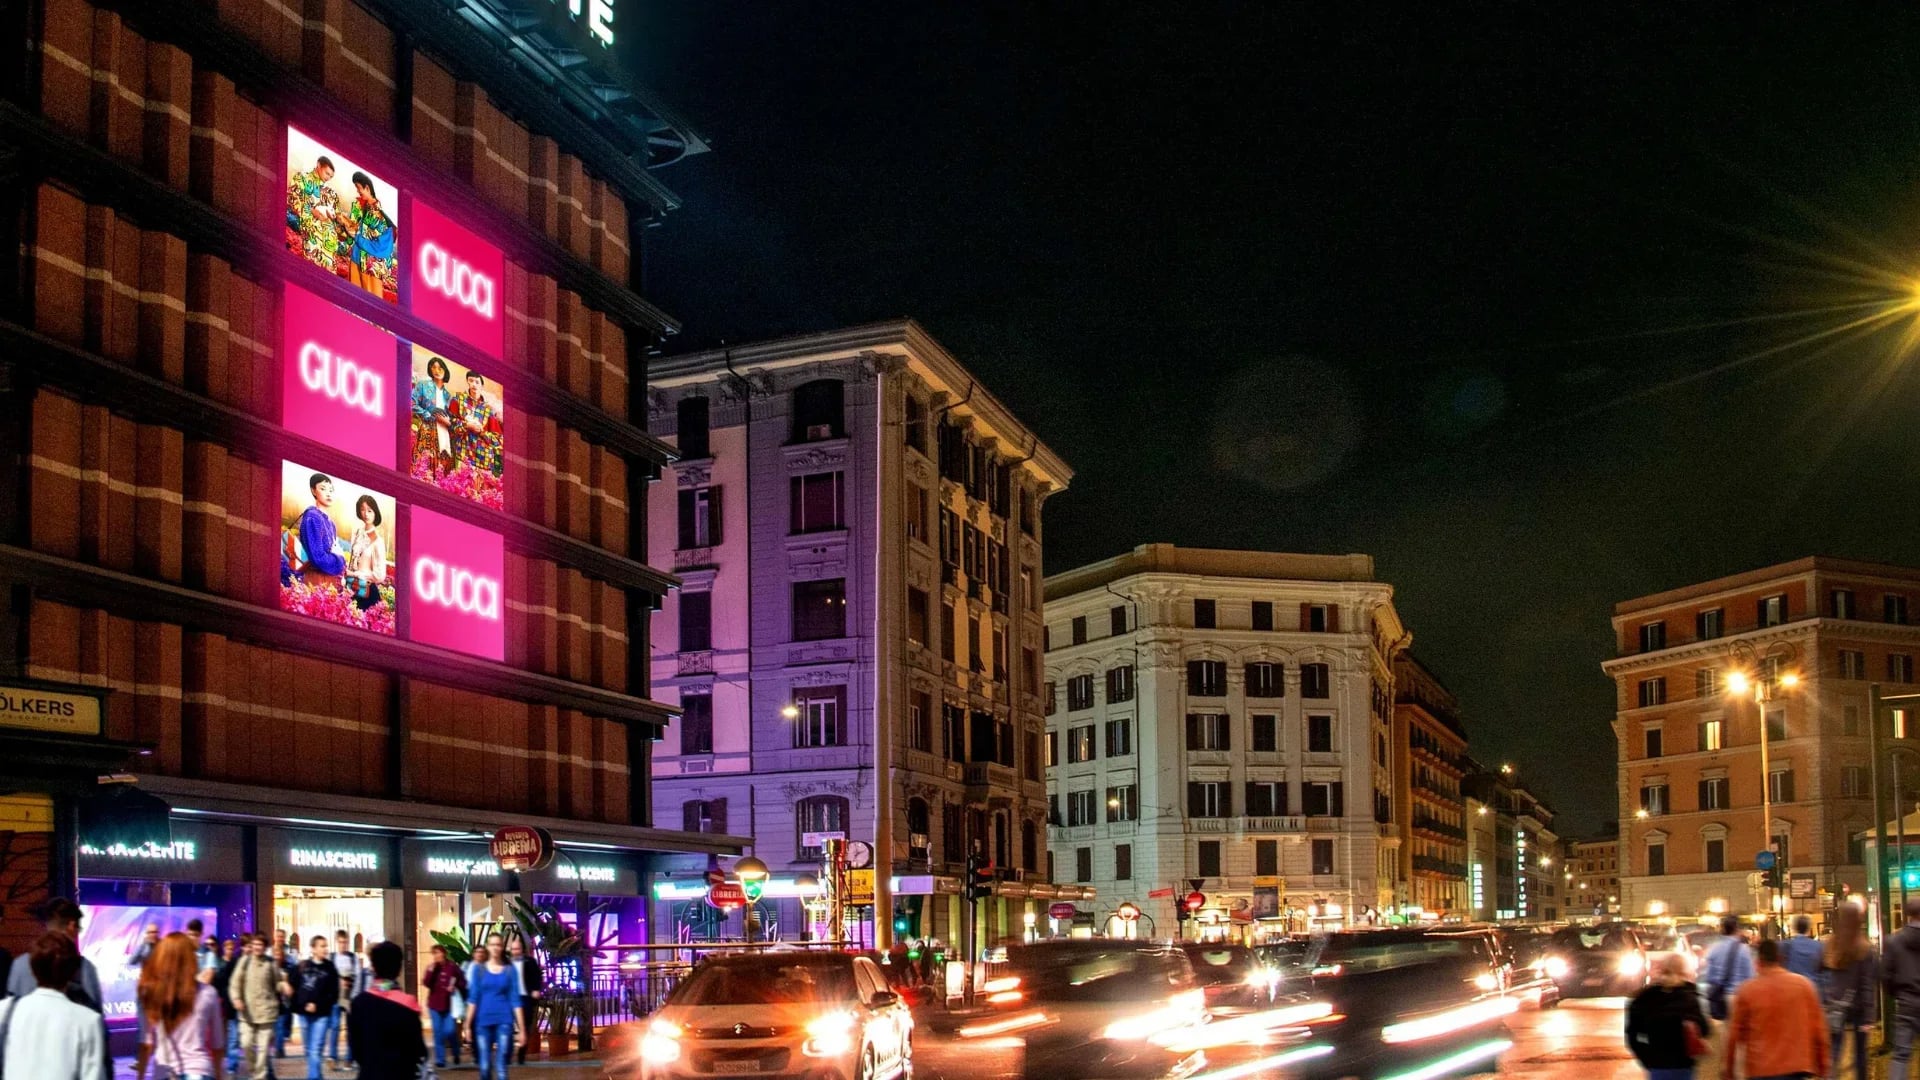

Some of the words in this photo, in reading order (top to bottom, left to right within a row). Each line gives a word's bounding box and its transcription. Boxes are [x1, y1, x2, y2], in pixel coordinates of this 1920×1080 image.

[420, 242, 492, 319] GUCCI
[300, 342, 382, 417] GUCCI
[415, 558, 498, 619] GUCCI
[80, 841, 195, 860] RACENTE
[290, 848, 377, 870] RINASCENTE
